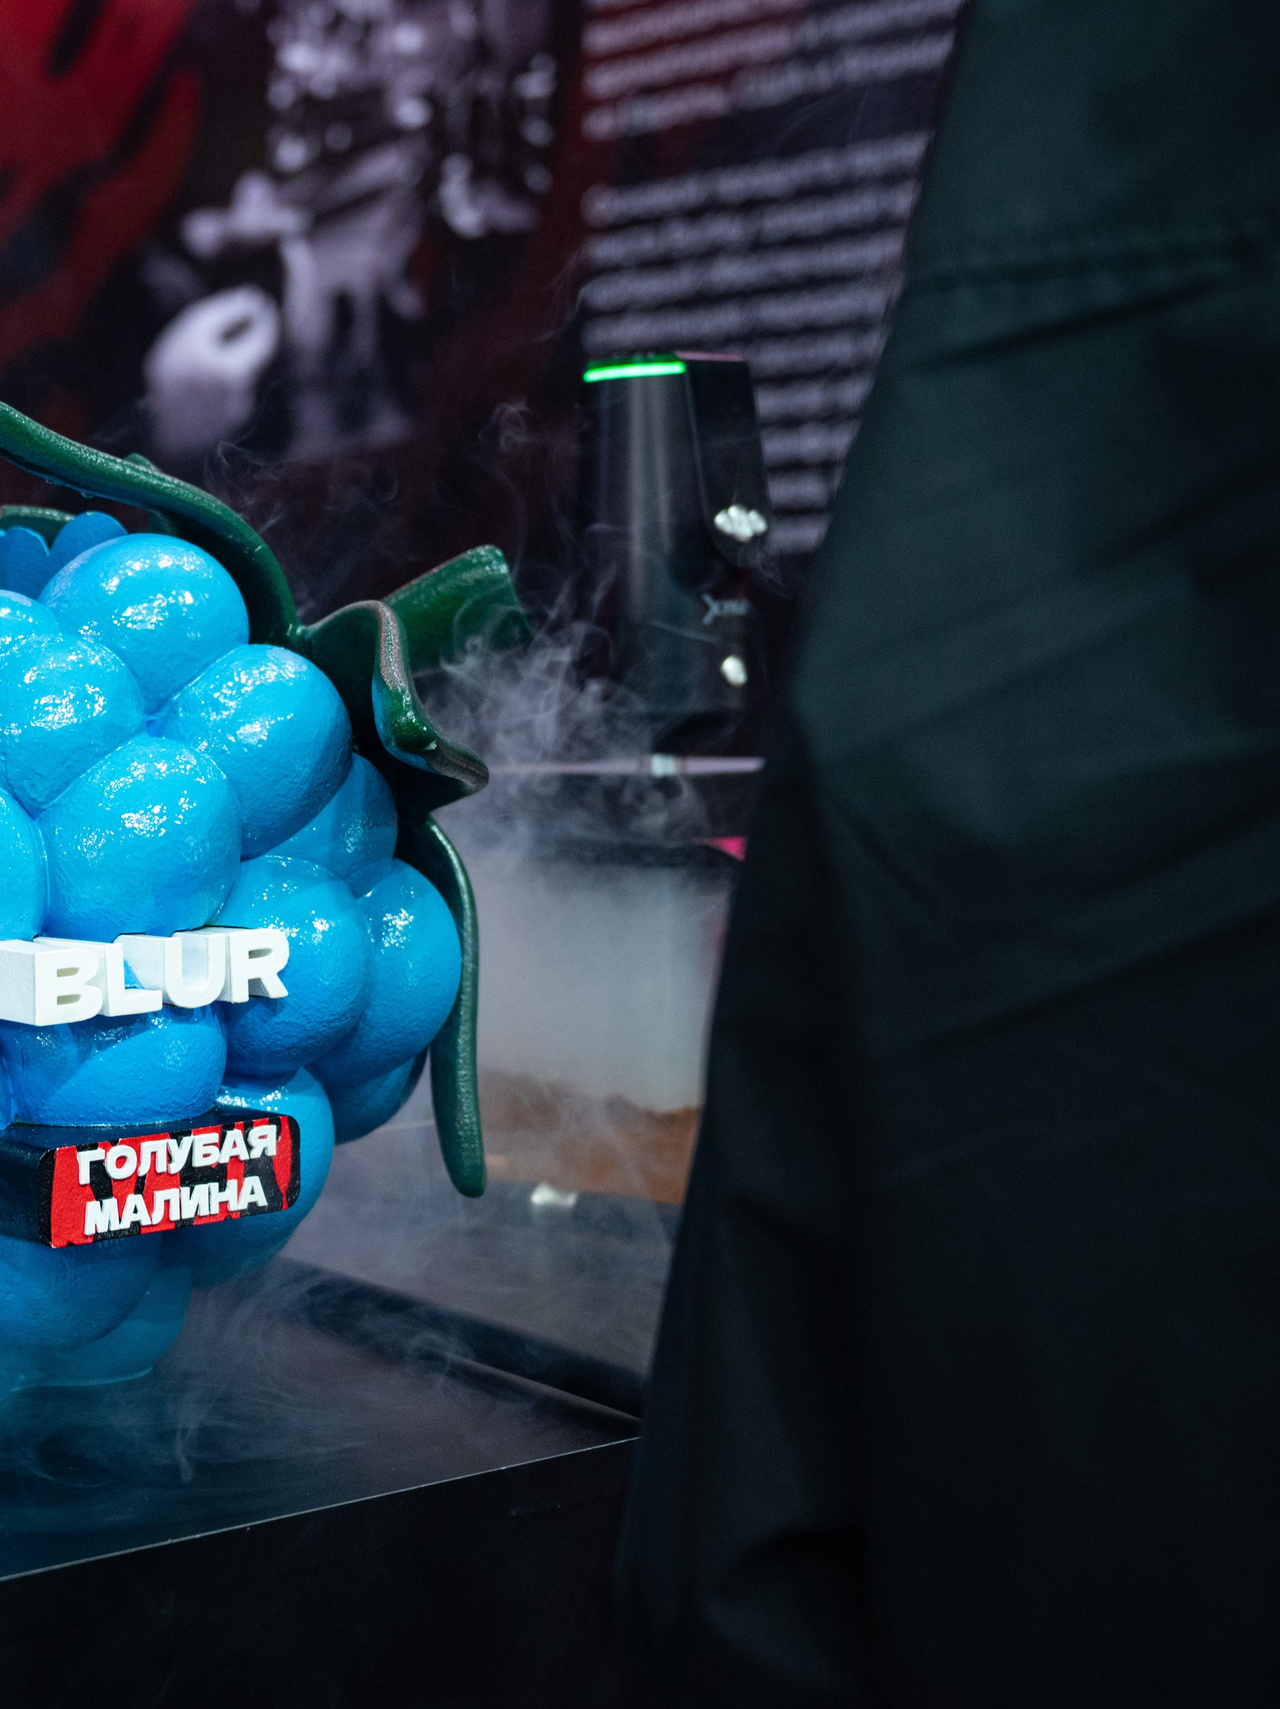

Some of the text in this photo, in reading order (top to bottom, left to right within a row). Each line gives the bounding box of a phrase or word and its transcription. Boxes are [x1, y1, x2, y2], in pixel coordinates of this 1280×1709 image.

[34, 926, 290, 1026] BLUR
[76, 1125, 277, 1185] ГОЛУБАЯ
[84, 1176, 268, 1236] МАЛИНА
